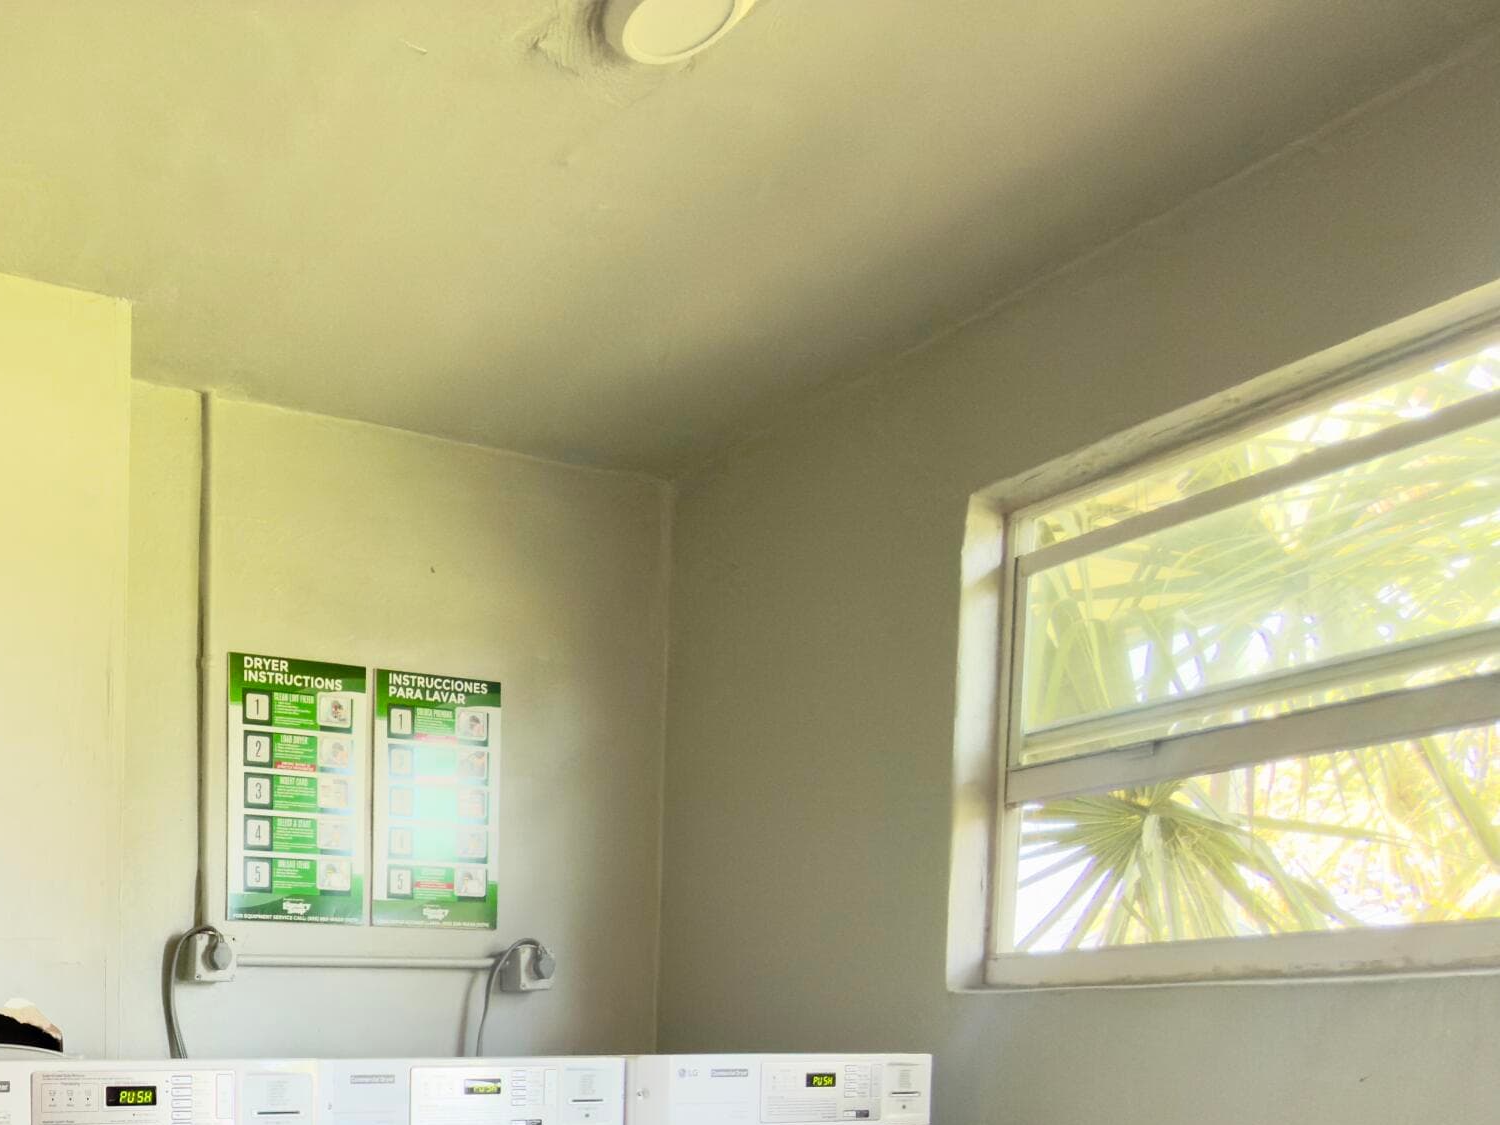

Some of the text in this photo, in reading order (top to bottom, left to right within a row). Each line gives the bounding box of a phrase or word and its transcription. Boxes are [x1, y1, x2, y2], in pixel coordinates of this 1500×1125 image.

[243, 656, 289, 672] DRYER
[243, 669, 343, 691] INSTRUCTIONS
[388, 673, 488, 694] INSTRUCCIONES
[388, 686, 466, 705] PARA LAVAR
[255, 740, 261, 757] 2
[255, 782, 262, 800] 3
[255, 825, 261, 840] 4
[255, 866, 261, 883] 5
[812, 1075, 833, 1086] PUSH
[119, 1090, 152, 1105] PUSH
